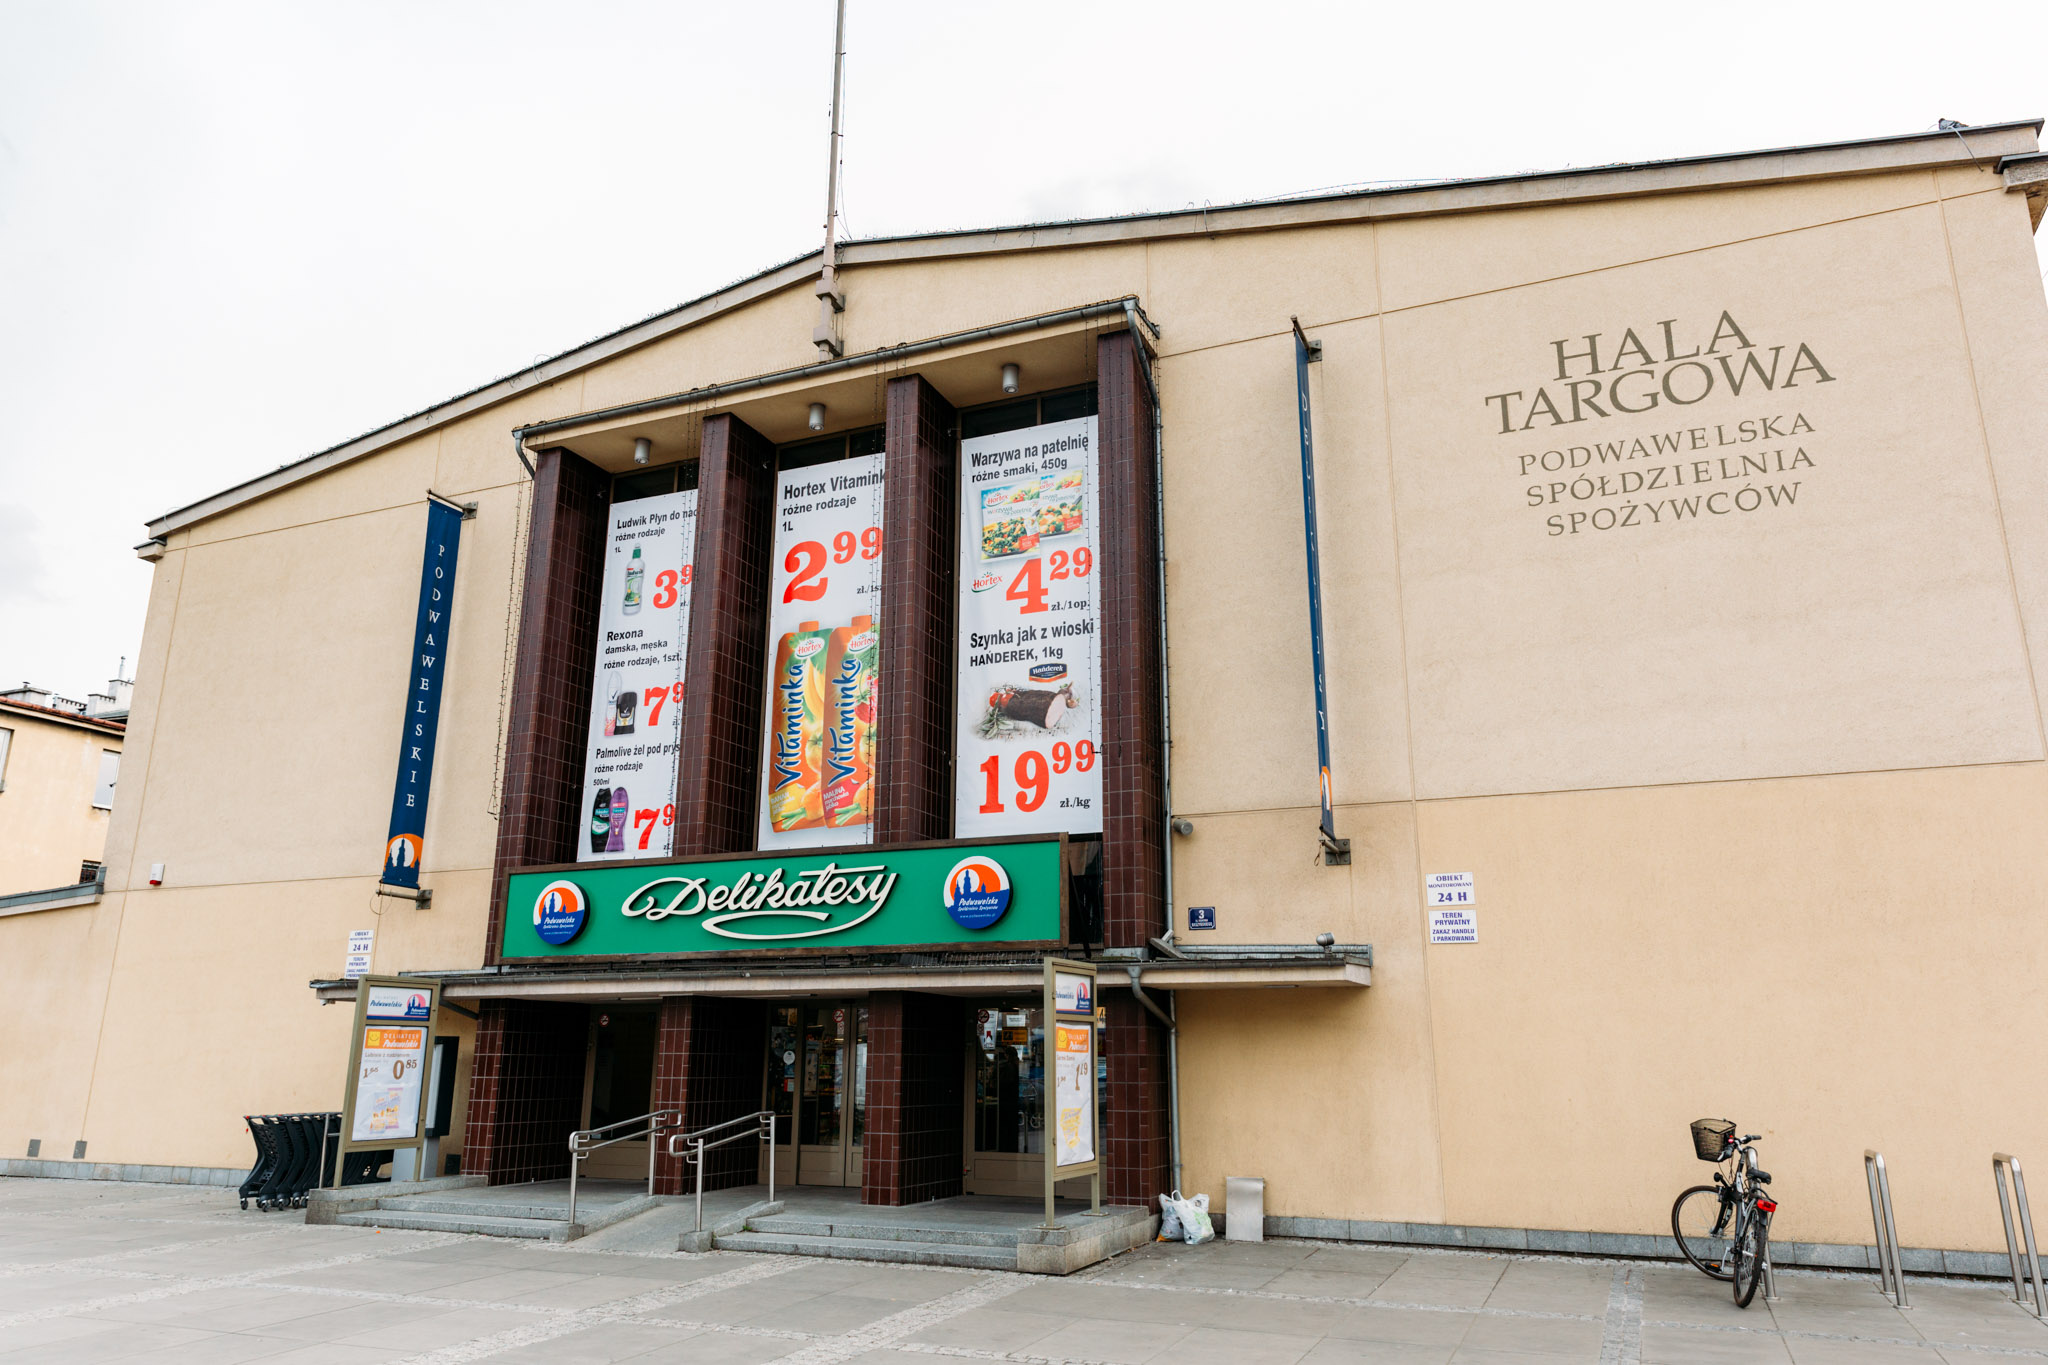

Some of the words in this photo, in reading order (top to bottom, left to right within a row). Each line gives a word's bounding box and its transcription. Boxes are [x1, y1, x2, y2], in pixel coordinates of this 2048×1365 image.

[1550, 310, 1756, 382] HALA
[1485, 342, 1836, 435] TARGOWA
[971, 448, 1021, 467] Warzywa
[1024, 445, 1038, 458] na
[1041, 434, 1089, 458] patelnię
[1518, 412, 1816, 476] PODWAWELSKA
[971, 470, 1000, 483] różne
[1003, 462, 1038, 477] smaki,
[1041, 458, 1068, 471] 450g
[1527, 447, 1816, 507] SPÓŁDZIELNIA
[784, 482, 826, 500] Hortex
[830, 468, 886, 492] Vitamink
[783, 503, 812, 516] różne
[816, 495, 857, 511] rodzaje
[1546, 481, 1802, 537] SPOŻYWCÓW
[617, 516, 647, 530] Ludwik
[649, 512, 667, 526] Płyn
[669, 510, 681, 521] do
[782, 521, 793, 532] 1L
[615, 532, 636, 542] różne
[637, 527, 665, 540] rodzaje
[972, 574, 1003, 590] Hortex
[606, 629, 643, 642] Rexona
[850, 636, 875, 649] Hortex
[970, 629, 1014, 651] Szynka
[1017, 626, 1037, 646] jak
[1040, 627, 1047, 639] z
[1051, 618, 1094, 638] wioski
[605, 643, 639, 655] damska,
[640, 639, 668, 651] męska
[798, 641, 823, 654] Hortex
[604, 661, 625, 670] różne
[627, 656, 660, 667] rodzaje,
[662, 653, 682, 663] 1szt.
[970, 647, 1038, 667] HAŃDEREK,
[1042, 646, 1063, 659] 1kg
[406, 544, 445, 808] PODWAWELSKIE
[1032, 664, 1064, 675] Hańderek
[774, 662, 805, 792] Vitaminka
[827, 657, 862, 787] Vitaminka
[595, 747, 631, 759] Palmolive
[633, 744, 645, 756] żel
[646, 743, 661, 757] pod
[594, 764, 614, 773] różne
[616, 761, 643, 772] rodzaje
[593, 778, 610, 786] 500ml
[823, 786, 846, 800] MALINA
[1060, 797, 1091, 809] zł./kg
[621, 863, 897, 940] Delikatesy
[959, 896, 998, 906] Podwawelska
[1437, 892, 1453, 903] 24
[1458, 892, 1467, 901] H
[1198, 910, 1205, 919] 3
